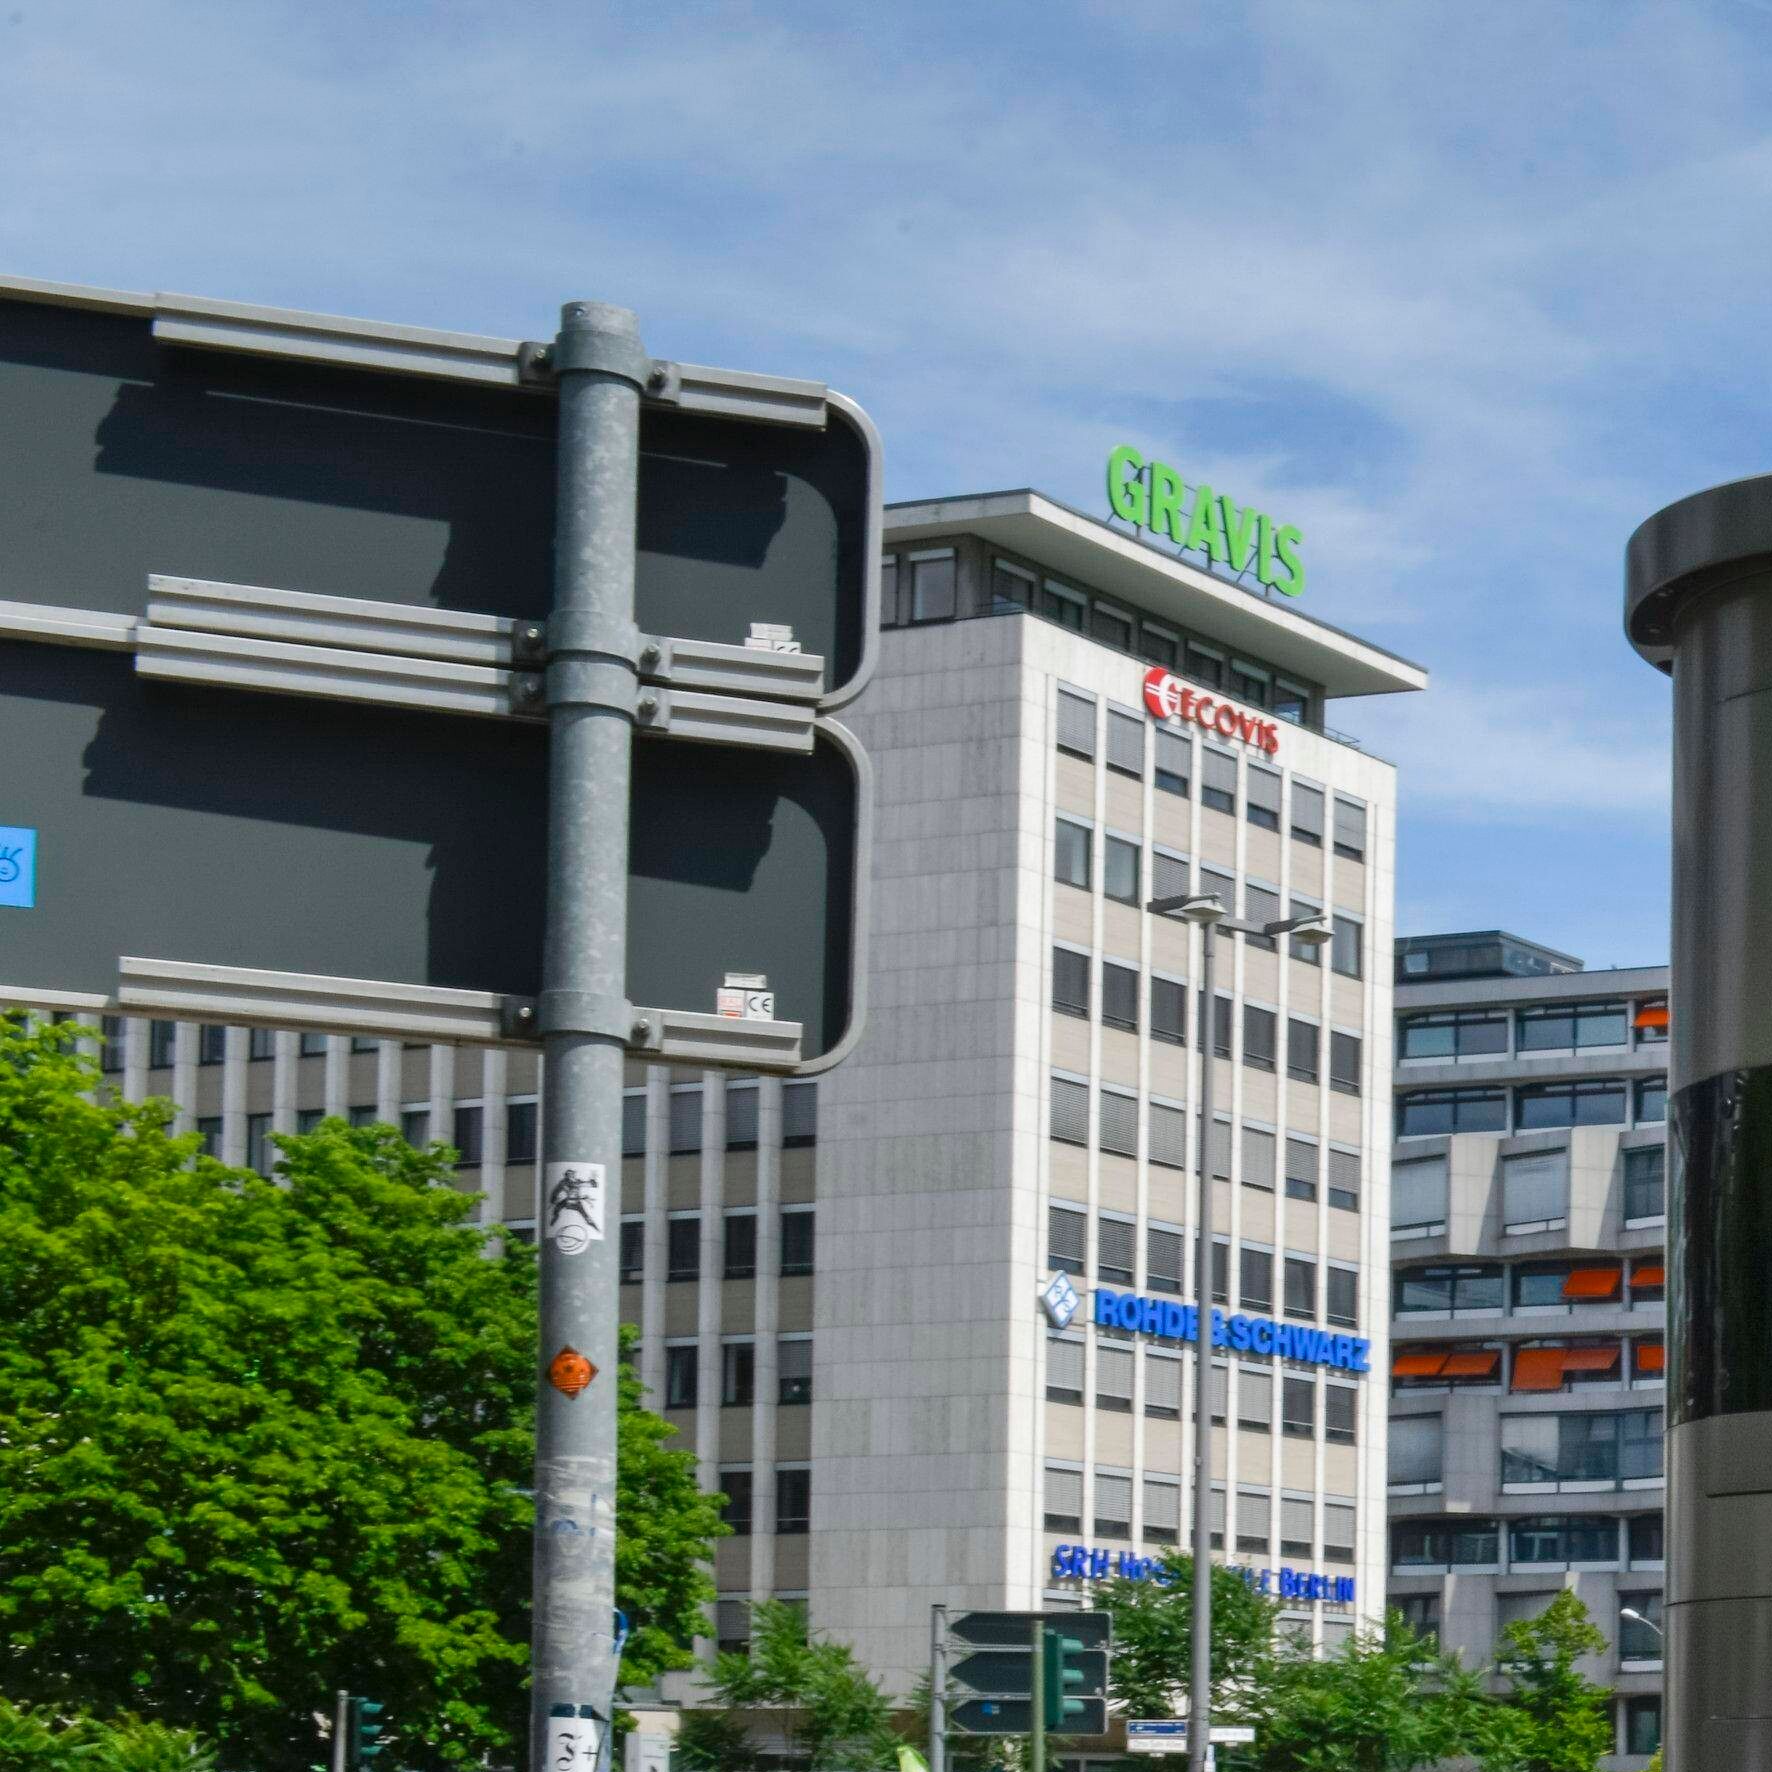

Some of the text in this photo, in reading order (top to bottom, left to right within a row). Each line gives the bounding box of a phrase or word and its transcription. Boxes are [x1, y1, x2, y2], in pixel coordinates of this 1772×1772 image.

[1108, 445, 1306, 597] GRAVIS
[1181, 688, 1279, 754] ECOVIS
[1095, 1288, 1199, 1341] ROHDE
[1211, 1309, 1230, 1346] &
[1229, 1314, 1371, 1372] SCHWARZ
[1052, 1544, 1110, 1579] SRH
